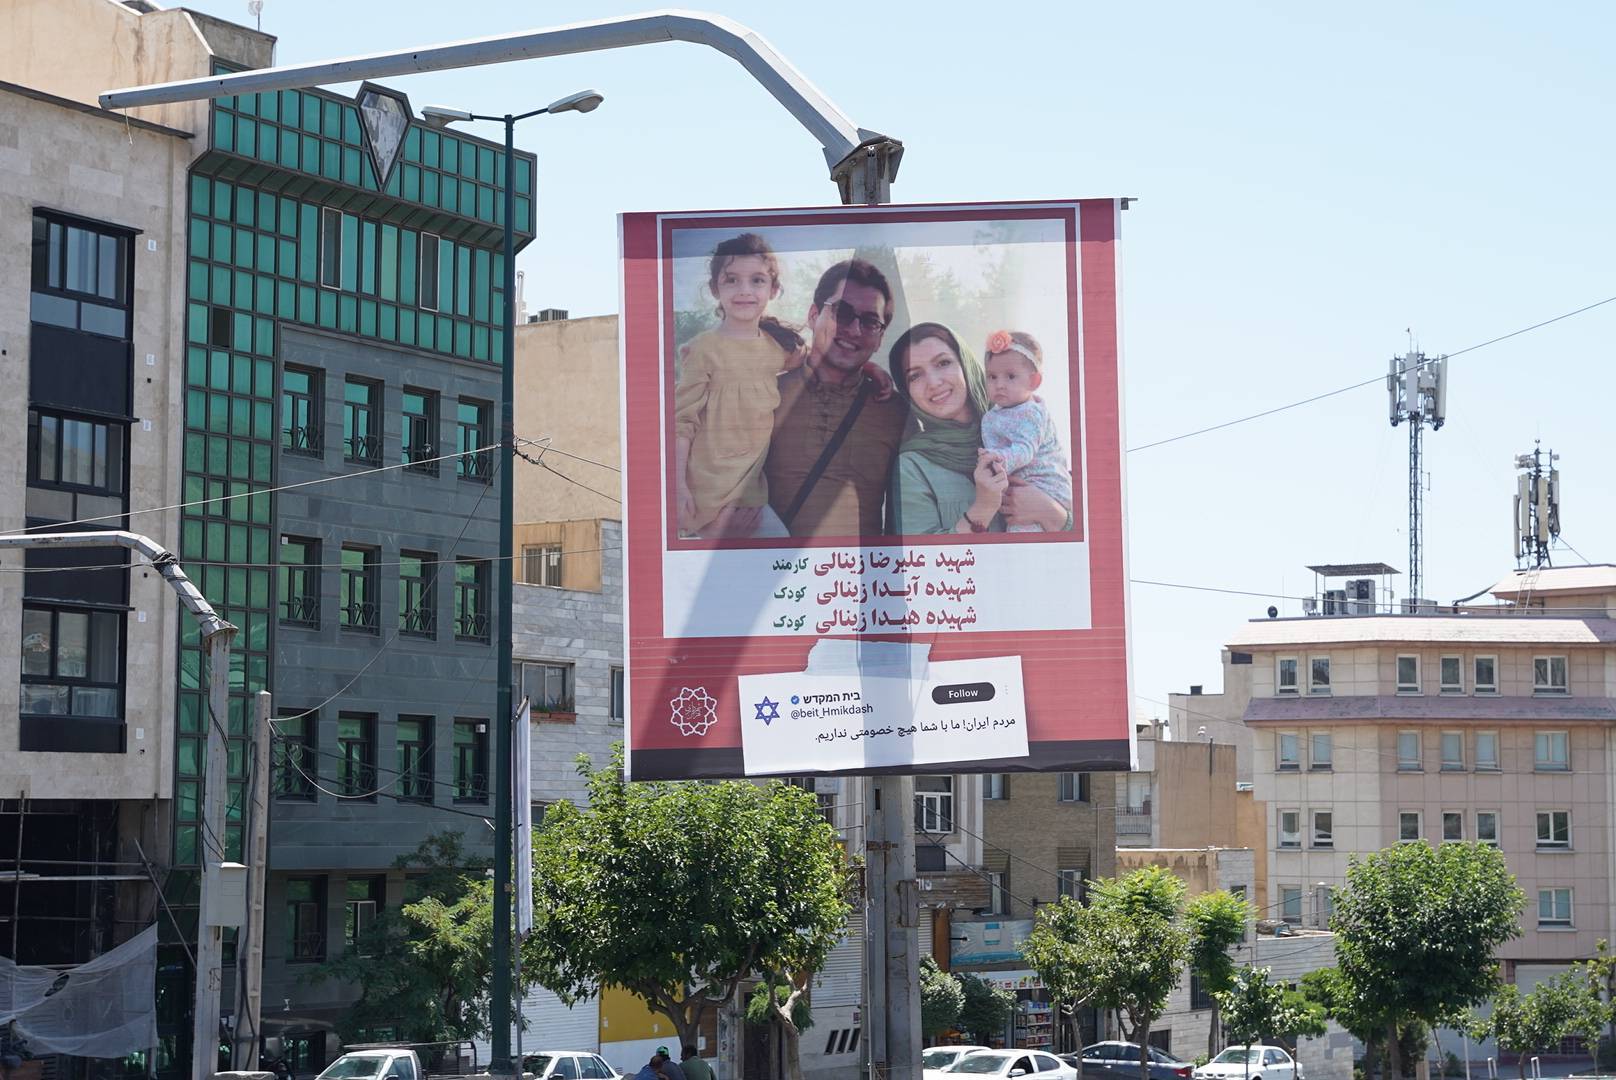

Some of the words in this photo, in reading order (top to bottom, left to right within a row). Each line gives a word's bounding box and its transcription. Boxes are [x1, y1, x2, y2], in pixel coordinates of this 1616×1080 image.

[772, 557, 809, 574] کارمند
[814, 551, 865, 576] زینالی
[869, 550, 925, 574] علیرضا
[935, 548, 975, 574] شهید
[773, 586, 807, 602] کودک
[816, 580, 868, 605] زینالی
[925, 577, 976, 602] شهیده
[773, 614, 806, 631] کودک
[815, 608, 867, 634] زینالی
[926, 606, 977, 631] شهیده
[802, 693, 840, 705] המקדש
[842, 691, 861, 701] בית
[948, 688, 979, 699] Follow
[790, 703, 874, 720] @beit_Hmikdash
[896, 724, 918, 738] هیچ
[920, 721, 938, 732] شما
[940, 719, 948, 732] با
[950, 719, 961, 730] ما
[962, 716, 989, 732] ایران!
[992, 717, 1016, 730] مردم
[815, 728, 847, 743] نداریم.
[850, 725, 894, 741] خصومتی
